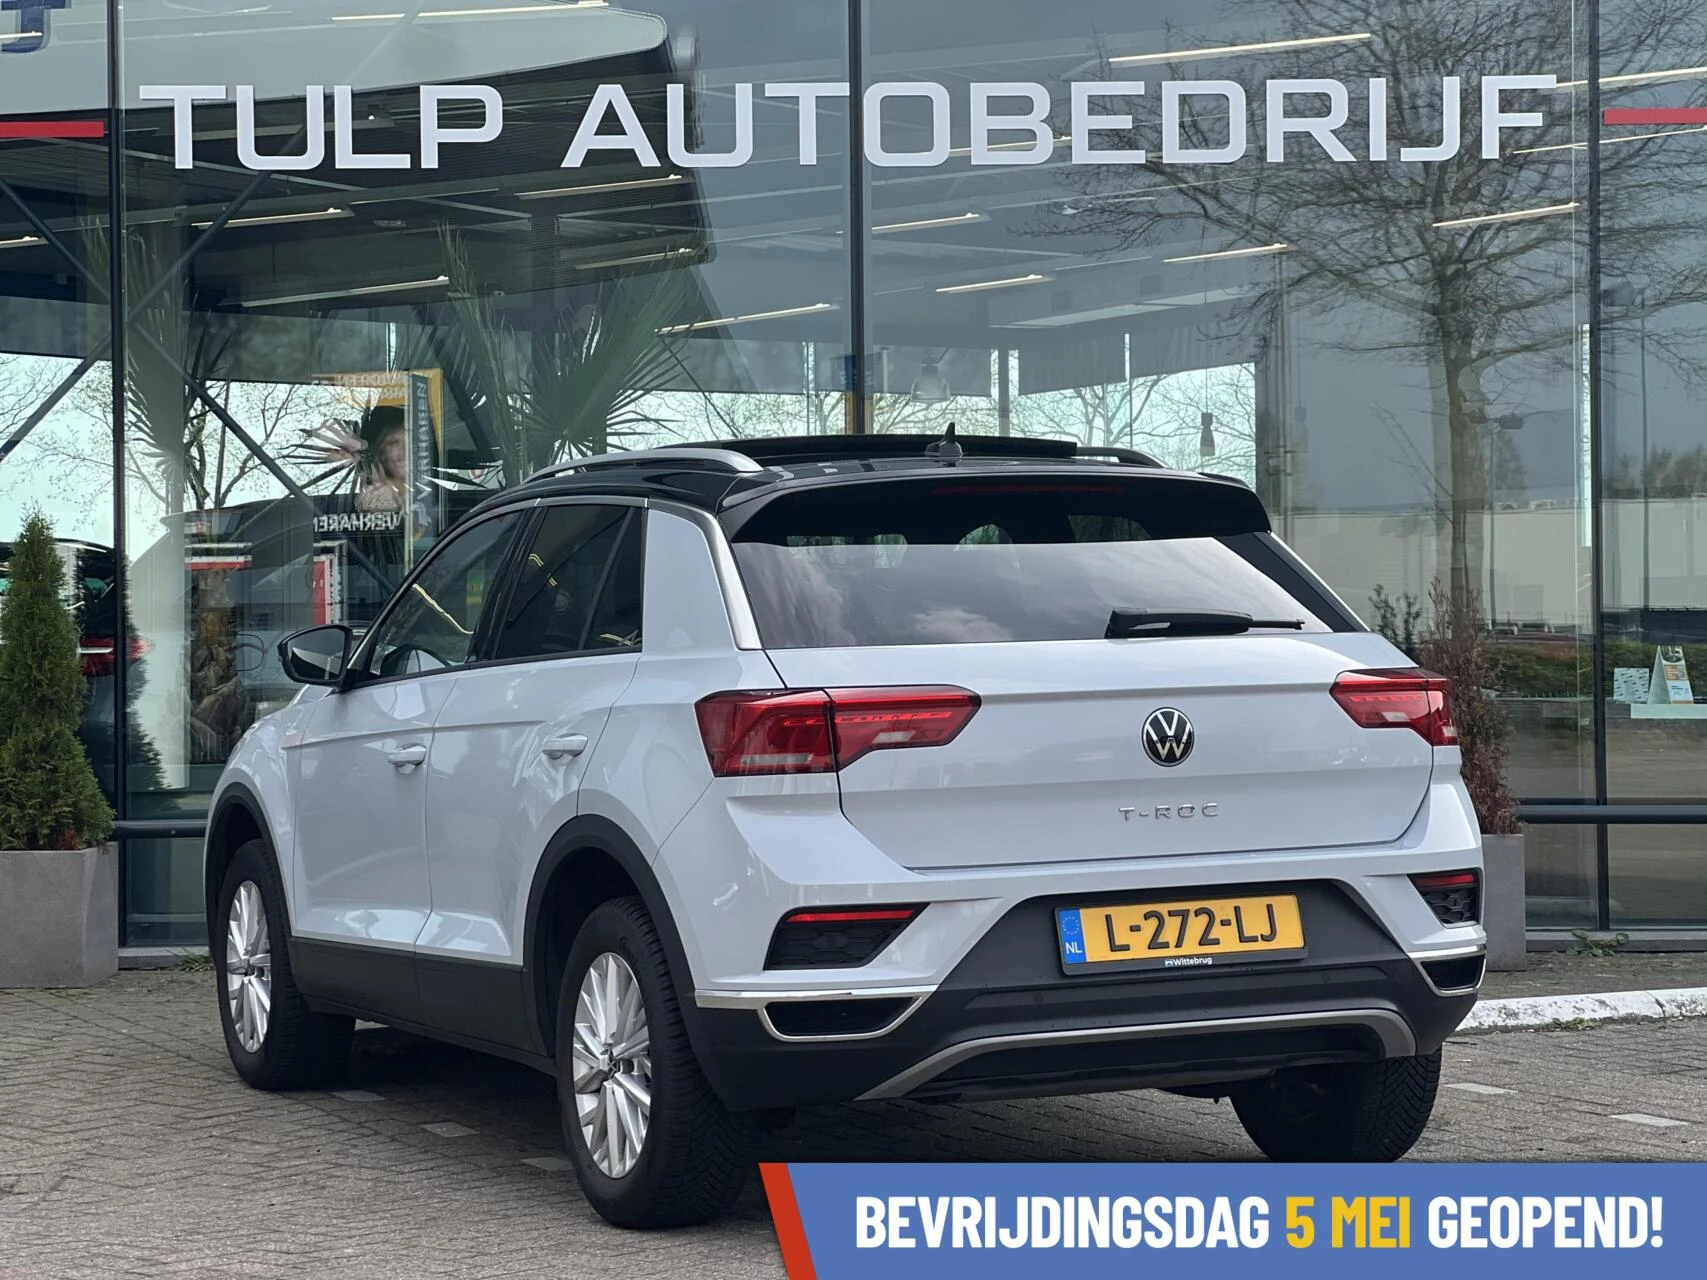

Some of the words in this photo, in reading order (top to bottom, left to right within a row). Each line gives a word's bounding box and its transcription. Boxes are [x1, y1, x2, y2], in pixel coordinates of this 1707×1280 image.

[139, 84, 503, 170] TULP
[560, 74, 1558, 169] AUTOBEDRIJF
[1118, 802, 1220, 821] T-ROC
[1104, 903, 1278, 953] L-272-LJ
[1065, 941, 1083, 955] NL
[1173, 957, 1213, 966] Wittebrug
